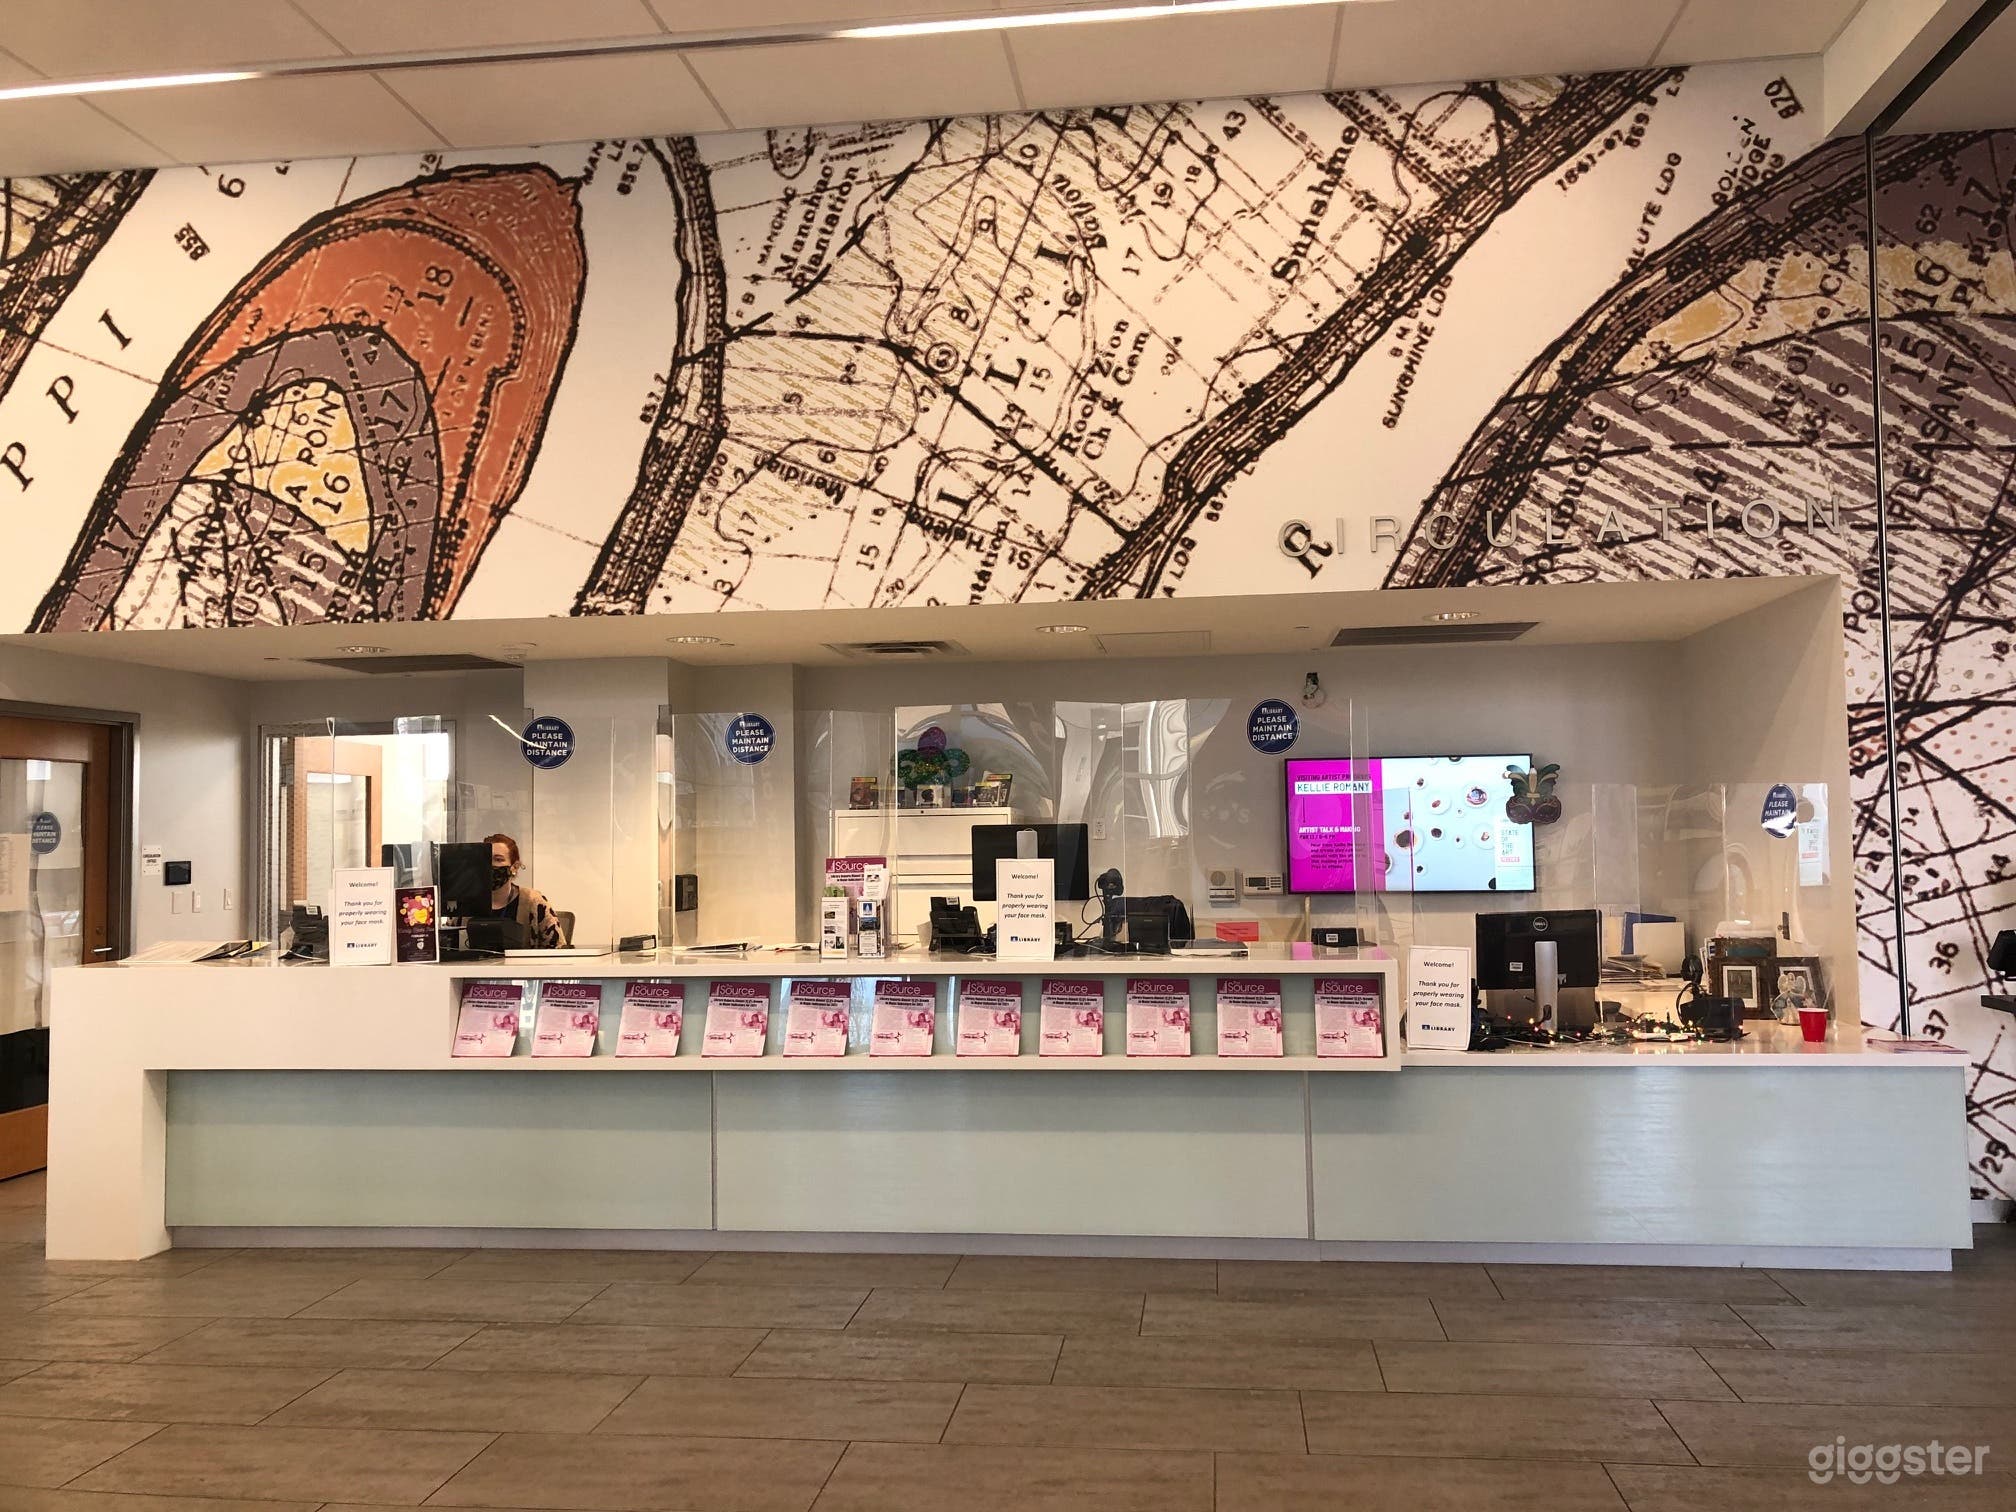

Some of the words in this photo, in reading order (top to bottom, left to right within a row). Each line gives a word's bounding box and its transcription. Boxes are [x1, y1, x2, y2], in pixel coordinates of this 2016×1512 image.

[1271, 124, 1360, 283] Sunshine
[791, 167, 858, 287] Plantation
[417, 265, 454, 306] 18
[46, 375, 79, 424] P
[98, 309, 132, 350] I
[297, 399, 341, 467] POIN
[753, 453, 849, 505] Meridian
[313, 472, 350, 514] 16
[1278, 494, 1841, 558] CIRCULATION
[1257, 715, 1287, 723] PLEASE
[1253, 724, 1292, 733] MAINTAIN
[732, 737, 769, 745] MAINTAIN
[1253, 732, 1293, 741] DISTANCE
[732, 745, 768, 753] DISTANCE
[1298, 783, 1330, 792] KELLIE
[1334, 782, 1370, 791] ROMANY
[1035, 893, 1044, 901] for
[1928, 941, 1960, 975] 36
[472, 986, 507, 997] Source
[551, 986, 587, 997] Source
[634, 985, 670, 996] Source
[720, 985, 755, 996] Source
[800, 984, 836, 995] Source
[885, 984, 921, 995] Source
[970, 983, 1007, 994] Source
[1051, 982, 1088, 993] Source
[1137, 982, 1173, 993] Source
[1227, 982, 1265, 993] Source
[1325, 982, 1363, 993] Source
[1922, 1009, 1949, 1040] 37
